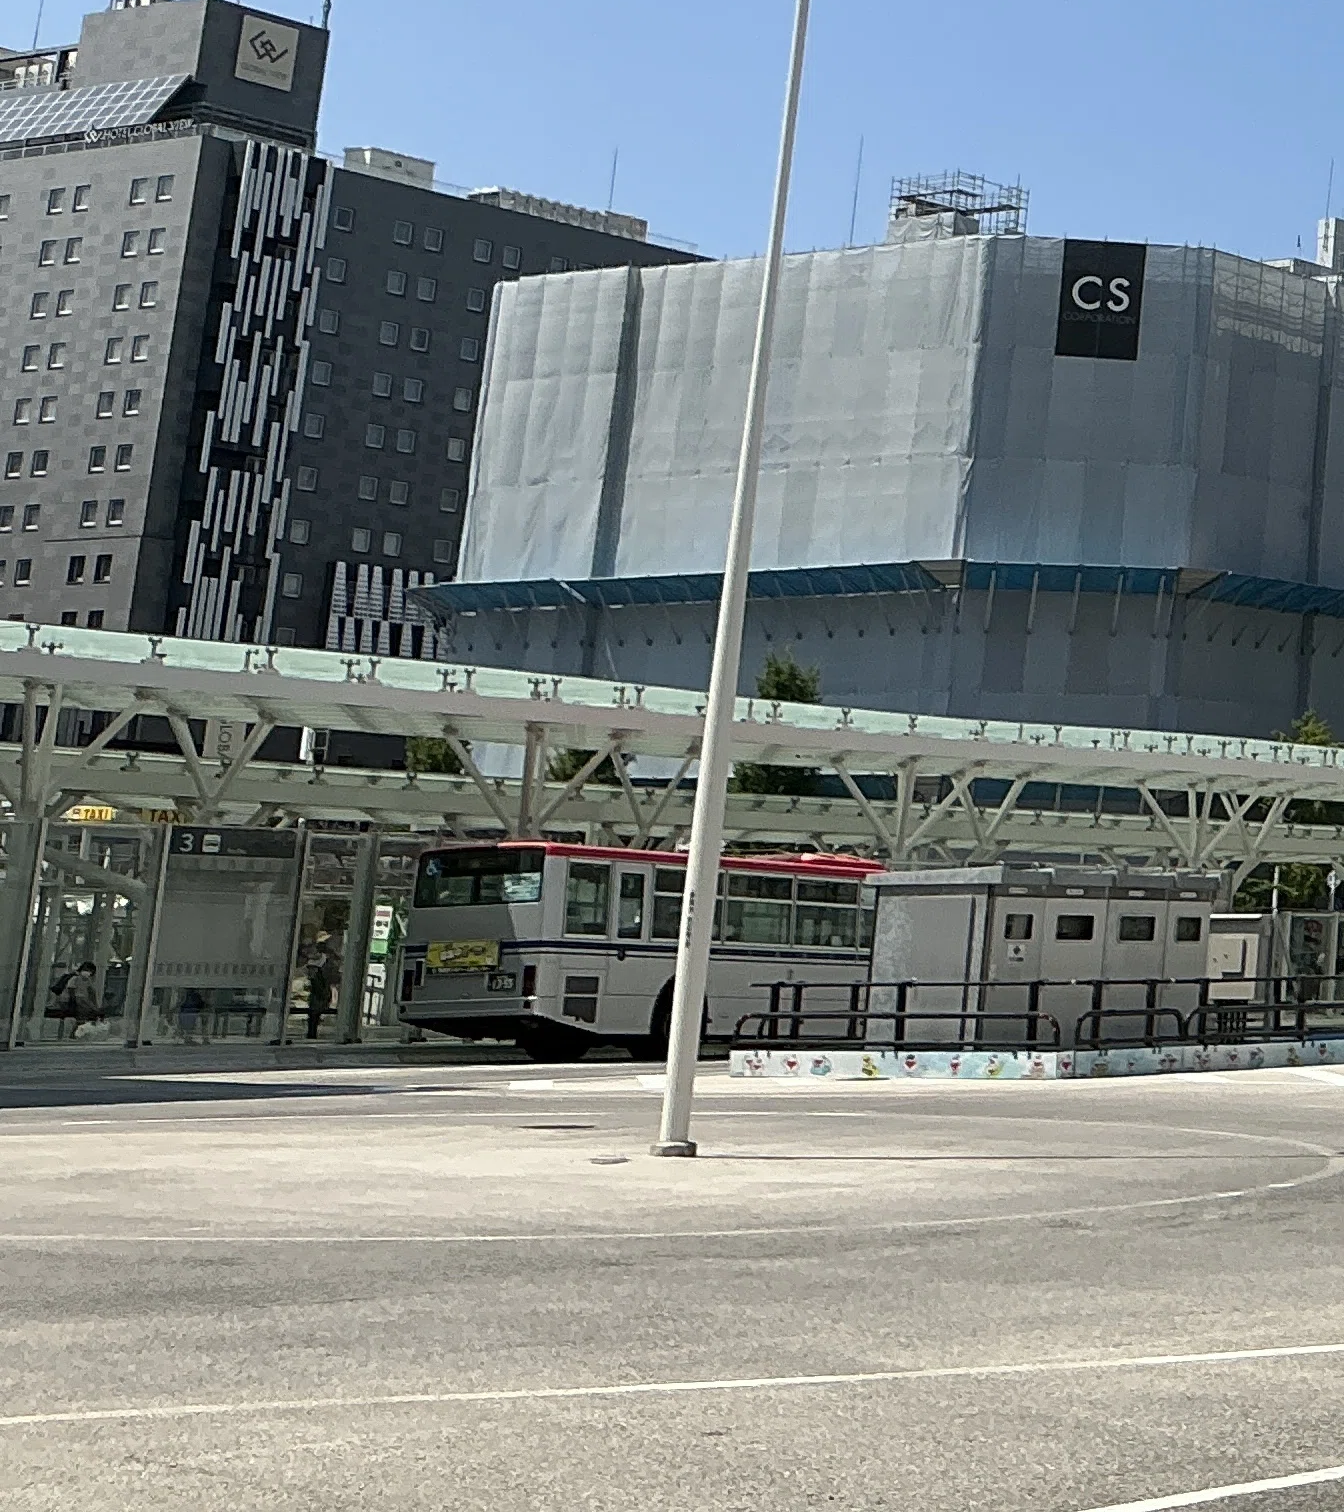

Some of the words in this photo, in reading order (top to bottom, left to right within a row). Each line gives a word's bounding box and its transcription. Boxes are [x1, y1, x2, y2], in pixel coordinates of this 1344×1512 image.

[1071, 275, 1131, 312] CS
[83, 808, 109, 820] TAXI
[179, 833, 194, 853] 3
